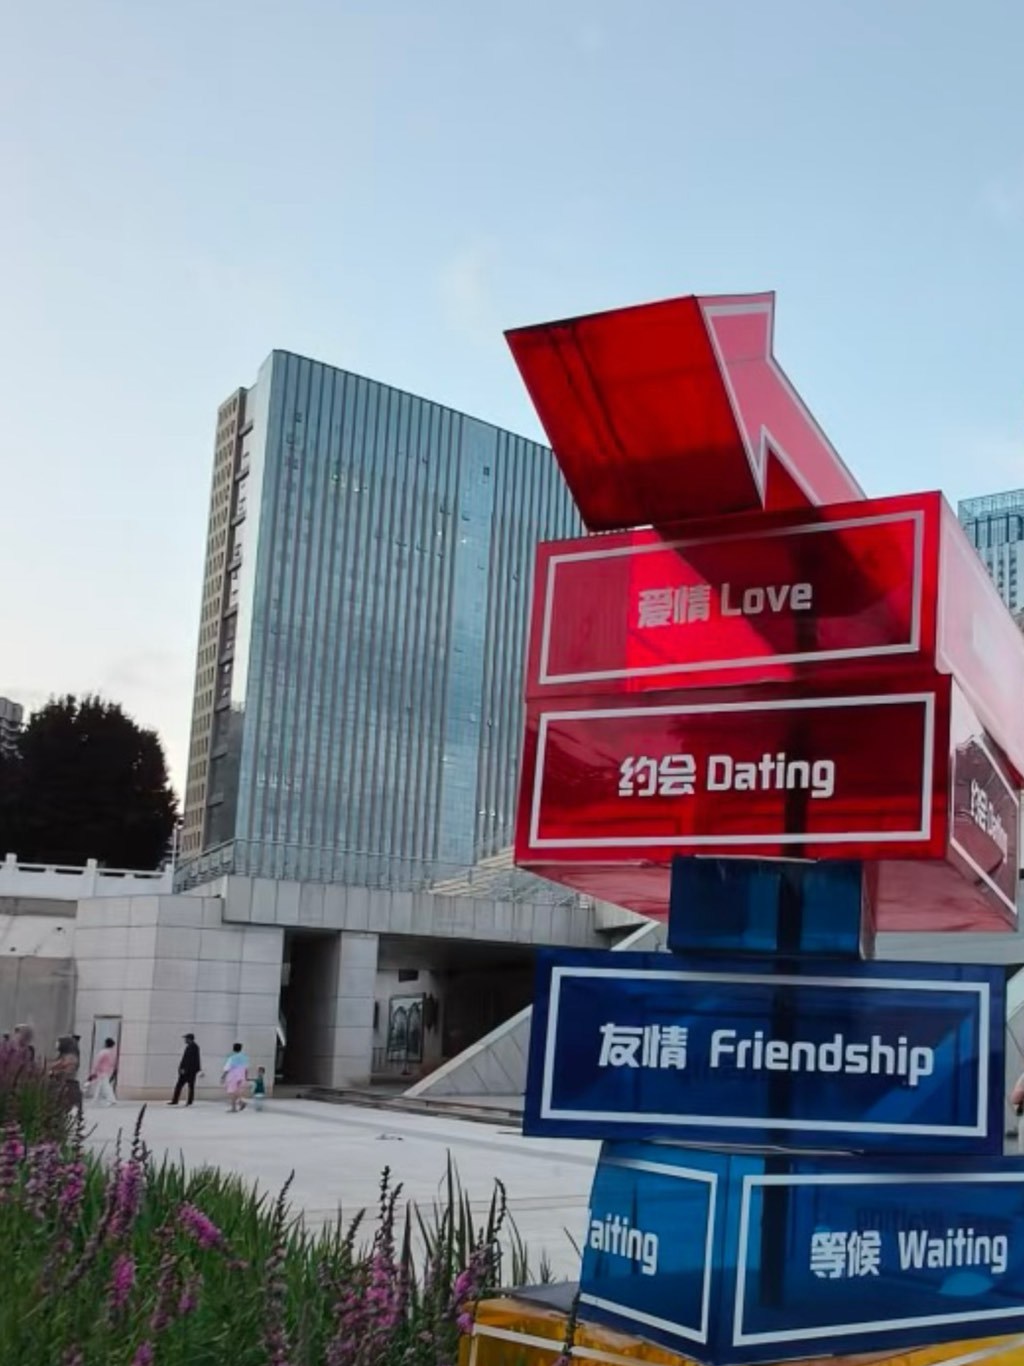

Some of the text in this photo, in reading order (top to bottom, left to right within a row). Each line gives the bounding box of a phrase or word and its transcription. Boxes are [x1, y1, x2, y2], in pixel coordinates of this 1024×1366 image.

[637, 582, 814, 629] 爱情 Love
[618, 753, 836, 799] 约会 Dating
[599, 1023, 935, 1087] 友情 Friendship
[588, 1210, 660, 1277] aiting
[810, 1226, 1009, 1280] 等候 Waiting
